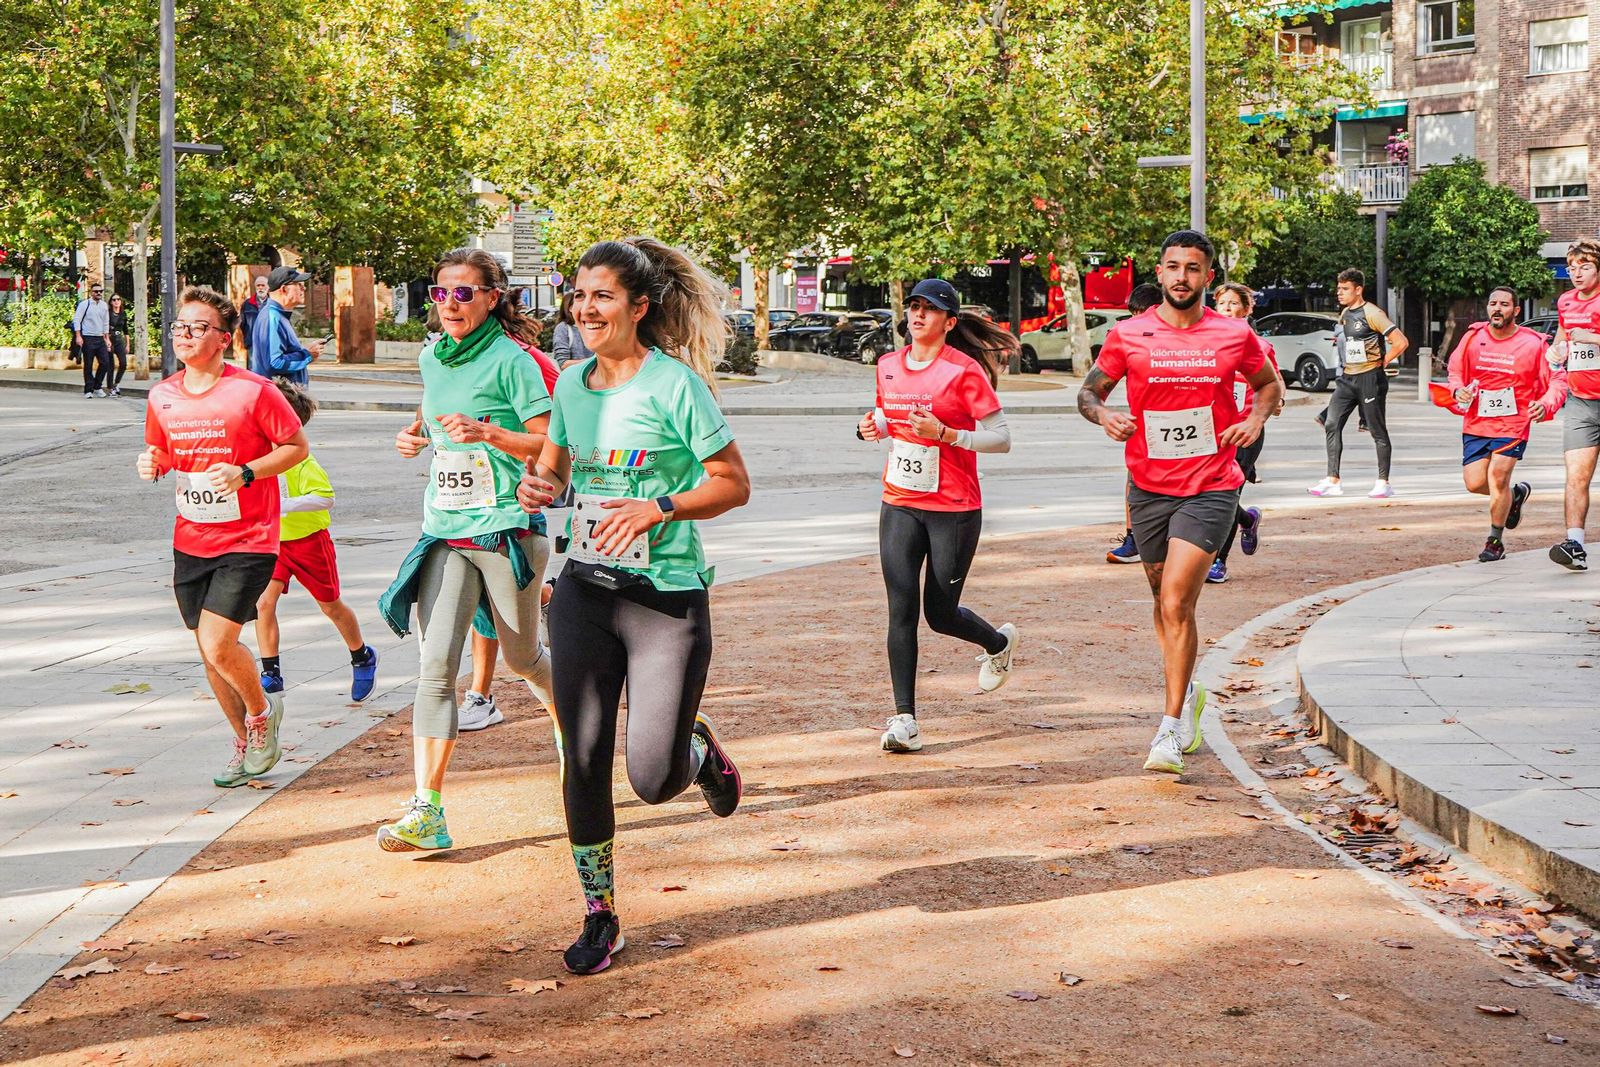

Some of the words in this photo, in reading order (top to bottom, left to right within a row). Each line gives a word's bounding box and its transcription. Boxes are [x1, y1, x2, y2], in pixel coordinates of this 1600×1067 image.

[1150, 349, 1201, 358] kilómetros
[1203, 349, 1216, 357] de
[1150, 358, 1217, 368] humanidad
[1148, 376, 1222, 384] #CarreraCruzRoja
[1489, 398, 1503, 408] 32
[212, 418, 225, 426] de
[169, 428, 226, 441] humanidad
[1160, 425, 1198, 442] 732
[438, 471, 474, 489] 955
